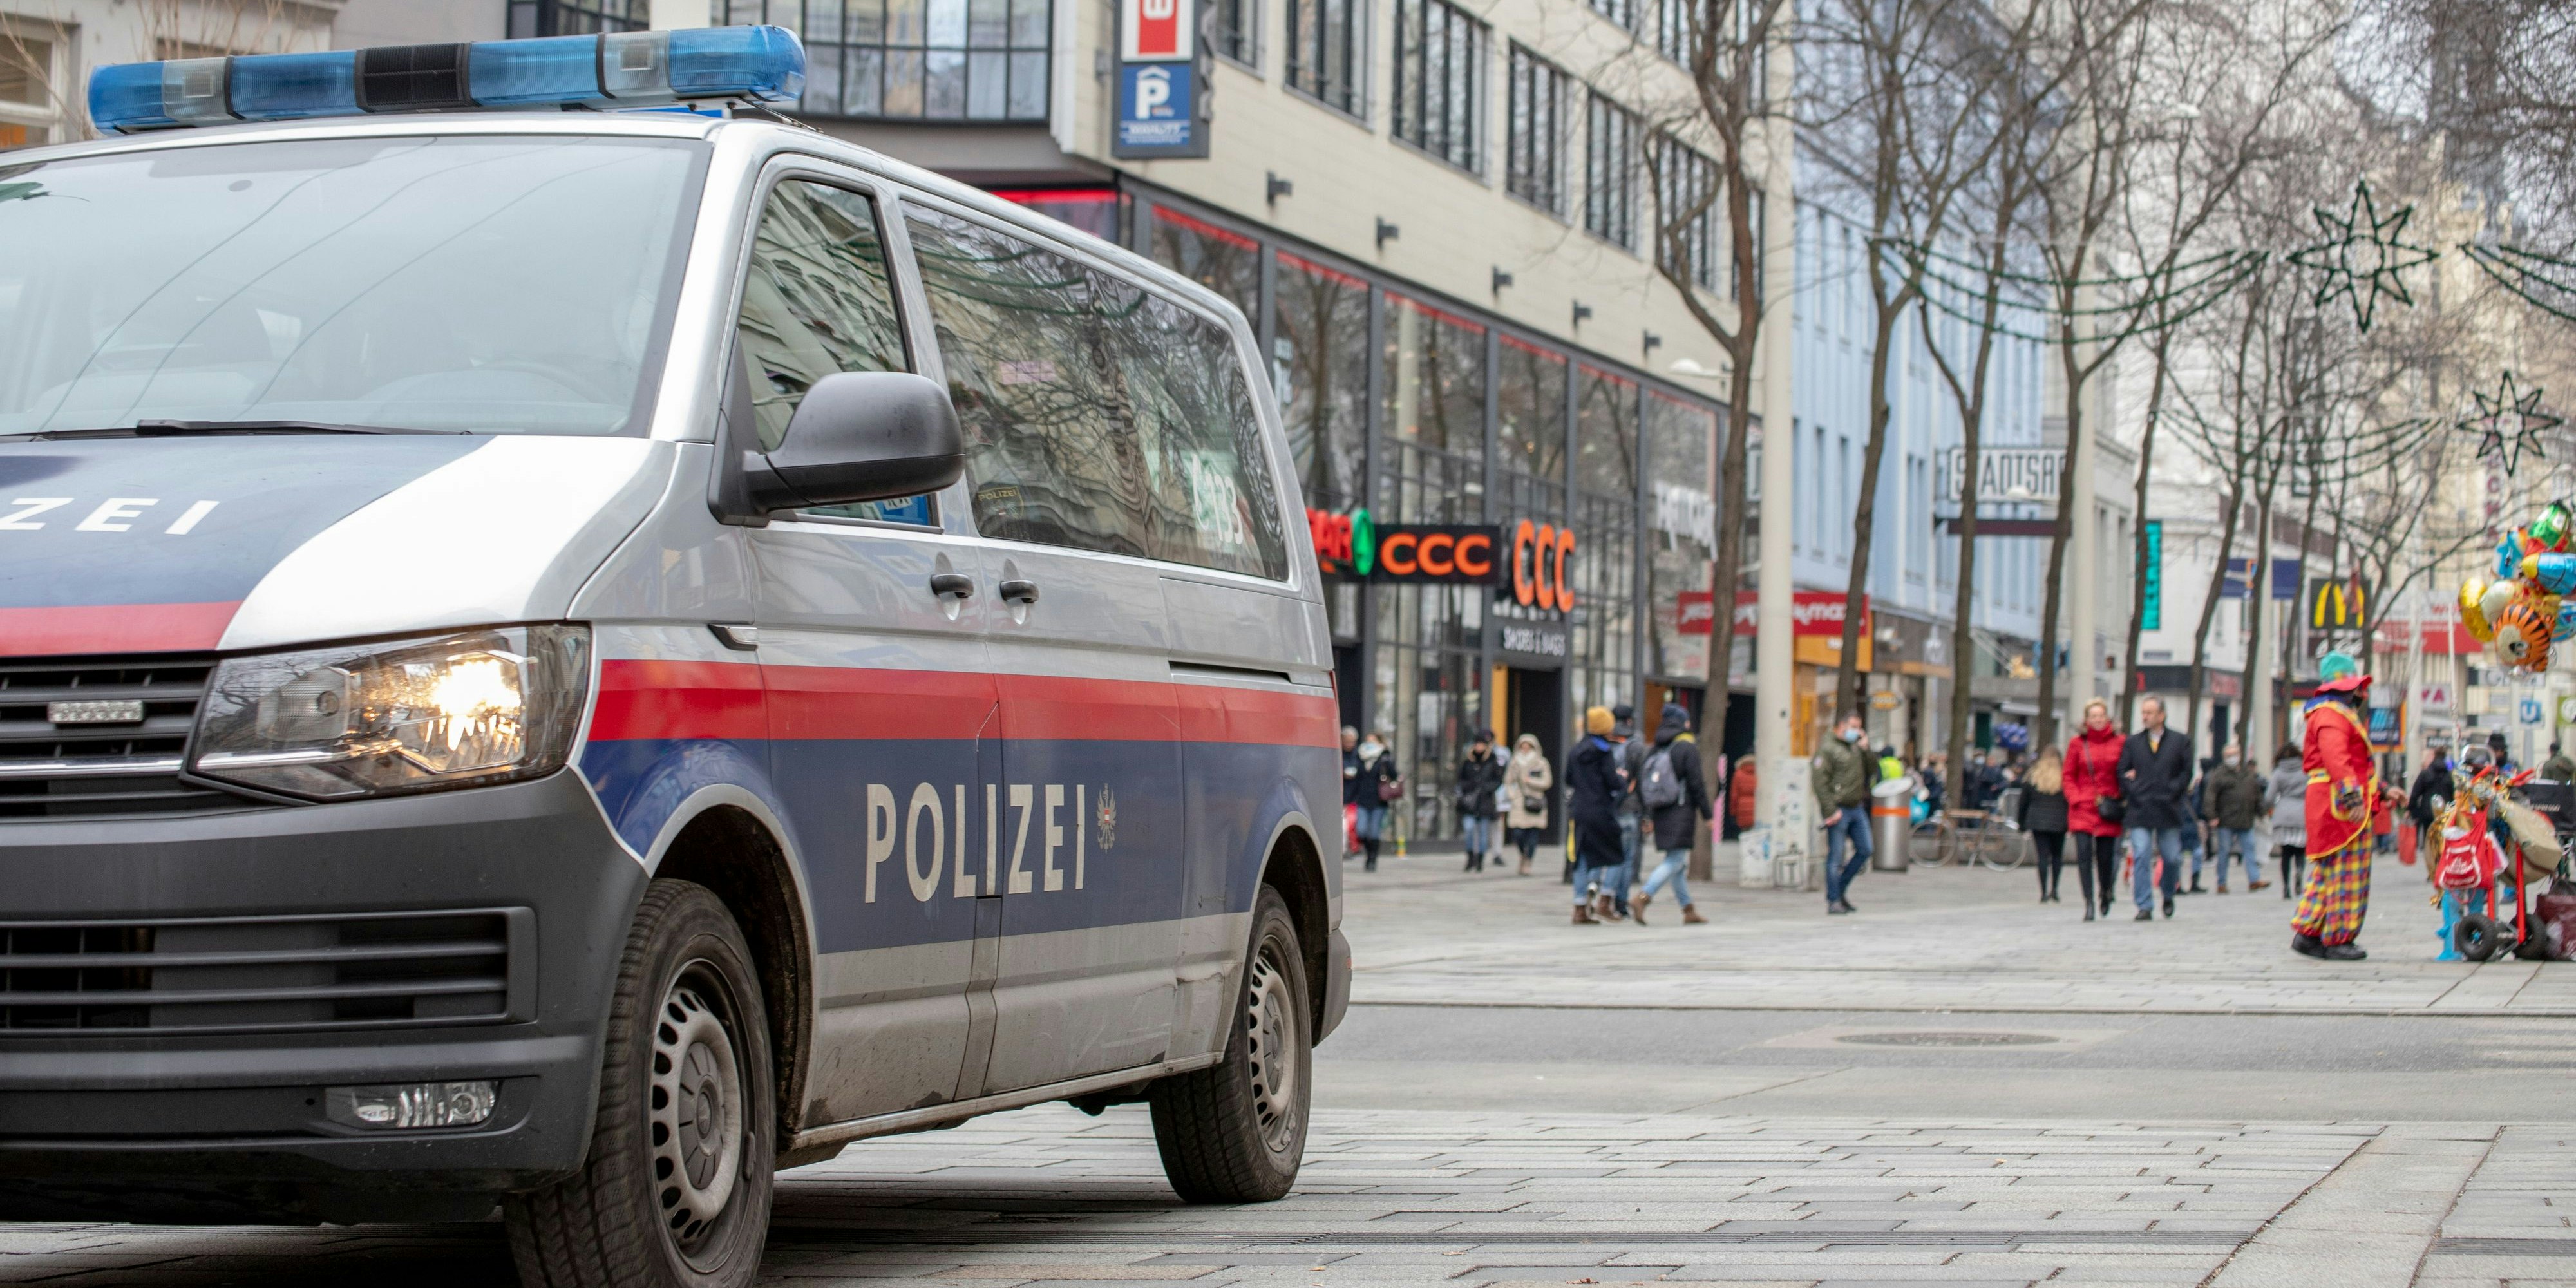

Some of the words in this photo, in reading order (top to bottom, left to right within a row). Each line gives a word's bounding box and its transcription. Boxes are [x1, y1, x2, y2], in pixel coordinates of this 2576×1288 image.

[1135, 78, 1171, 120] P
[0, 498, 220, 535] ZEI
[978, 489, 1017, 502] POLIZEI
[1205, 473, 1244, 545] 133
[1380, 532, 1492, 576] CCC
[1513, 518, 1575, 612] CCC
[2521, 703, 2537, 722] U
[865, 782, 1086, 903] POLIZEI
